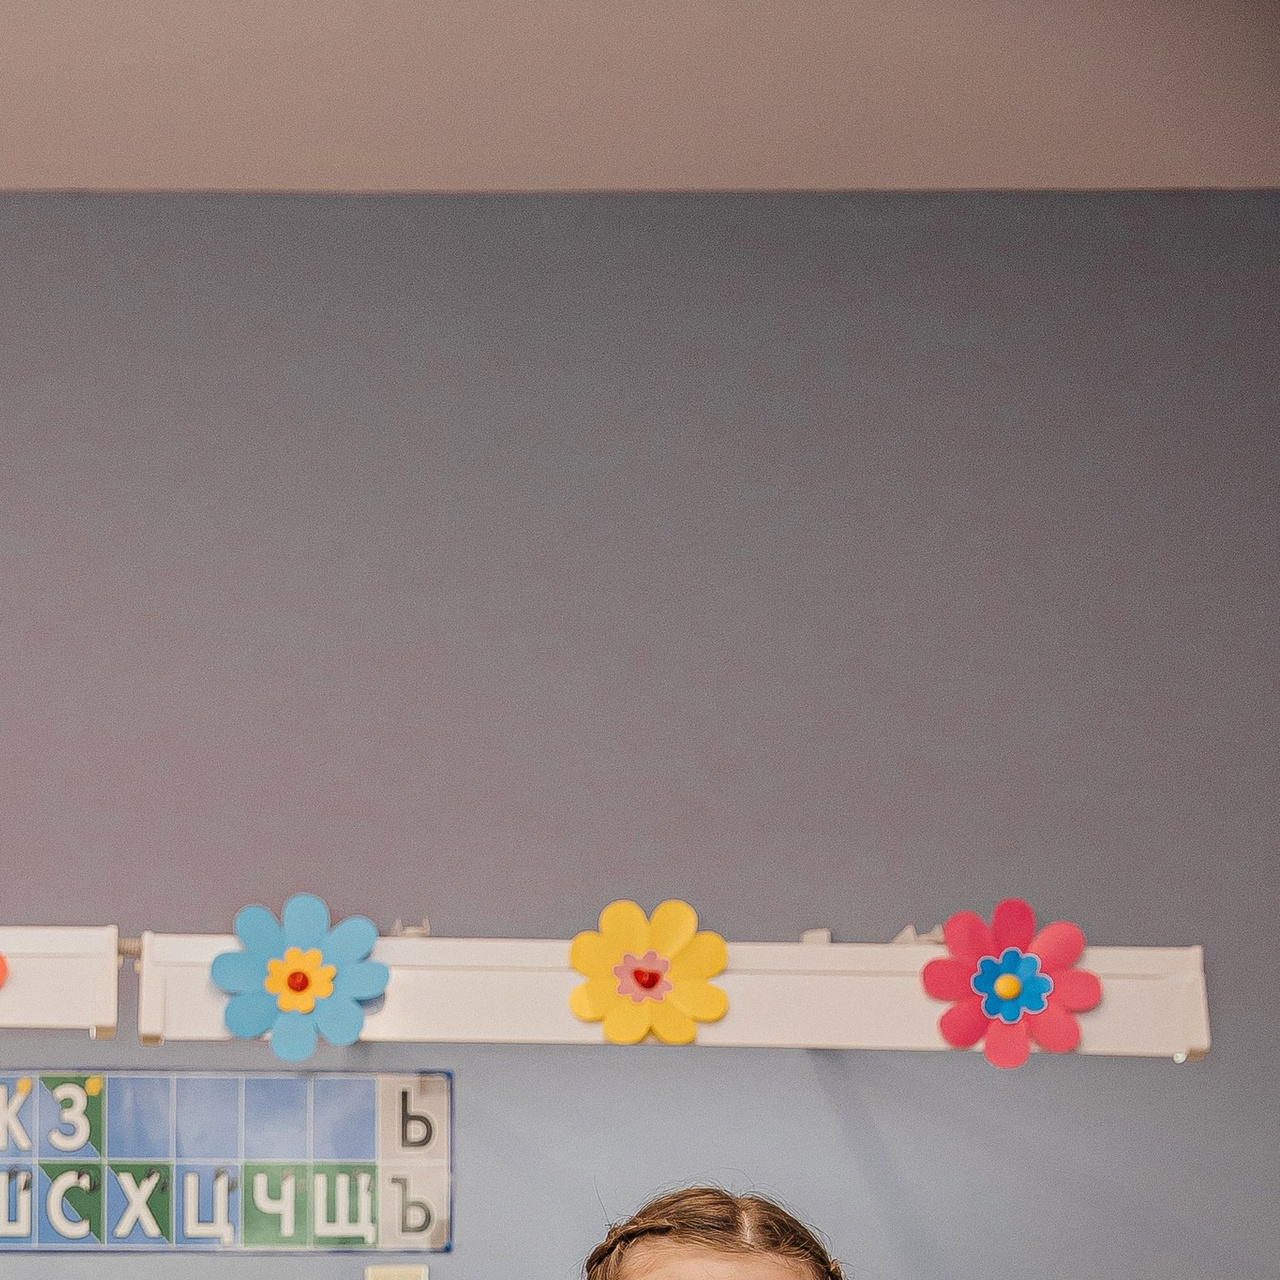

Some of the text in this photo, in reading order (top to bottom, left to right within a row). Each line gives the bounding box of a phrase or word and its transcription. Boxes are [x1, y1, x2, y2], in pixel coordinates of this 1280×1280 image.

[47, 1082, 91, 1152] З
[401, 1089, 433, 1148] Ь
[45, 1170, 91, 1240] С
[112, 1171, 162, 1238] Х
[183, 1172, 233, 1244] Ц
[252, 1173, 296, 1238] Ч
[314, 1172, 376, 1244] Щ
[391, 1177, 432, 1234] Ъ
